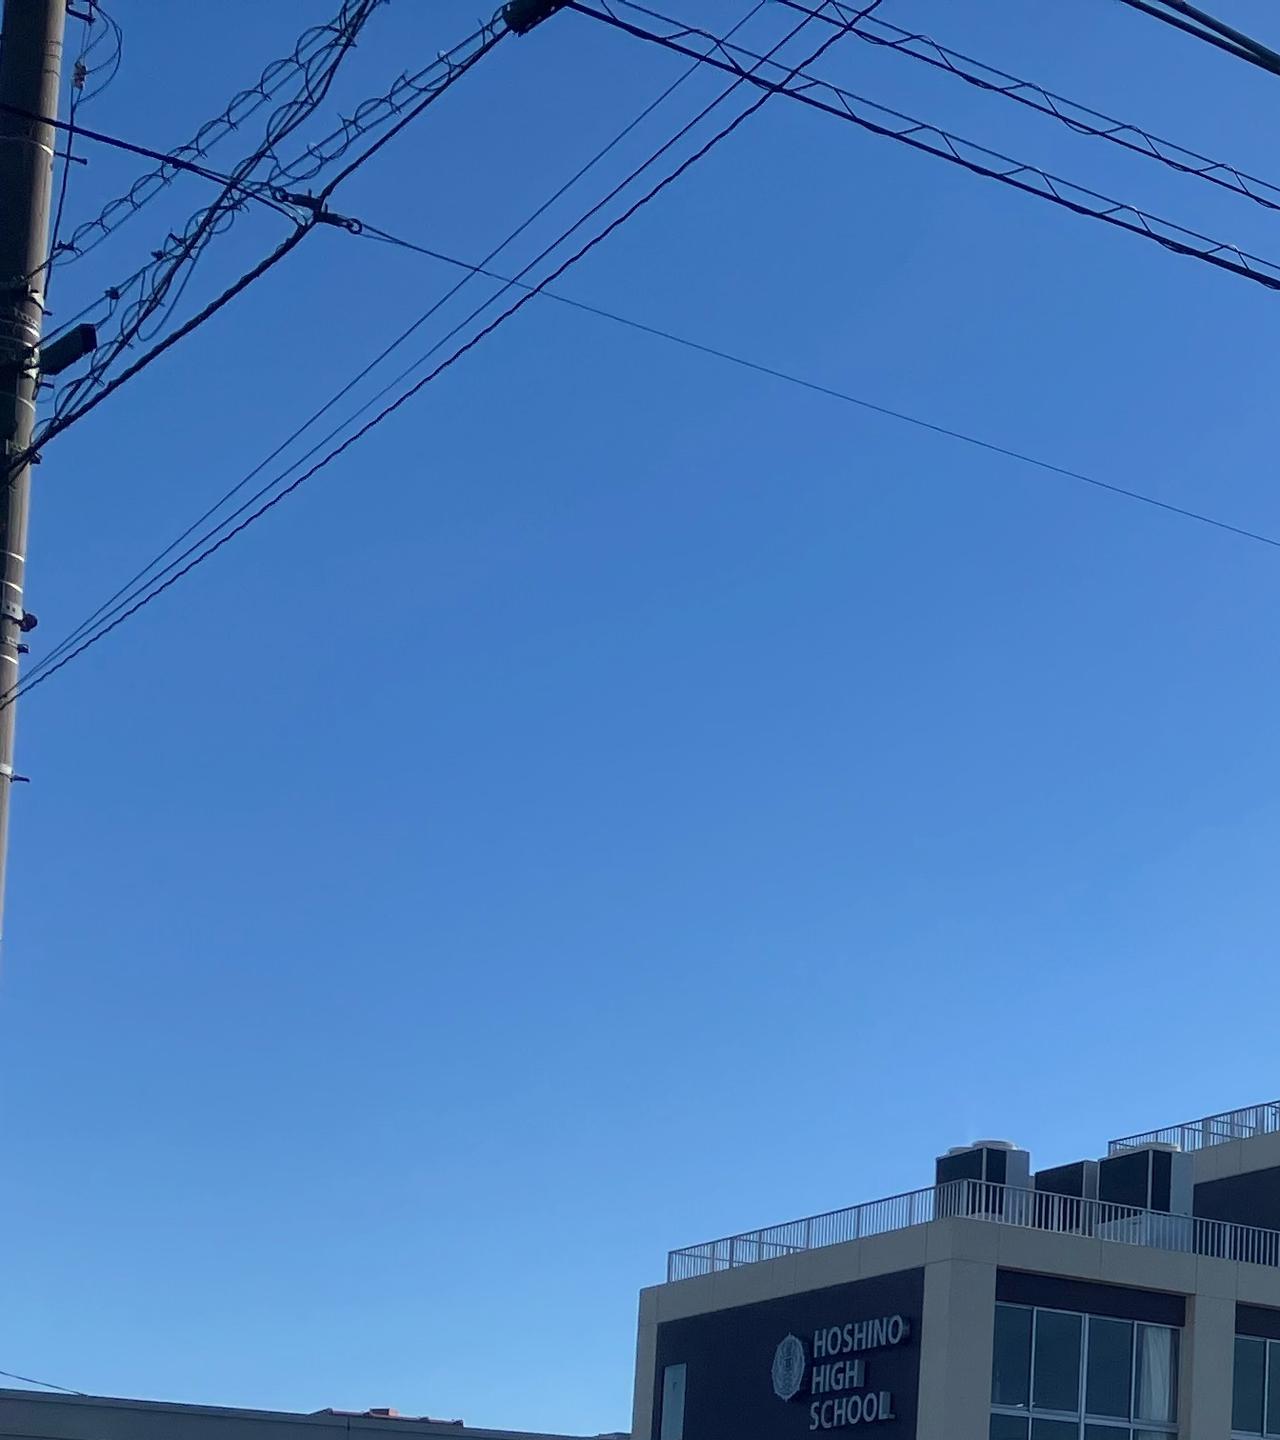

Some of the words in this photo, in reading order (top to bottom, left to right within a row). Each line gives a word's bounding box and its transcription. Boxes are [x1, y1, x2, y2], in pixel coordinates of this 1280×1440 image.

[813, 1315, 905, 1358] HOSHINO
[811, 1359, 862, 1394] HIGH
[809, 1391, 896, 1431] SCHOOL
